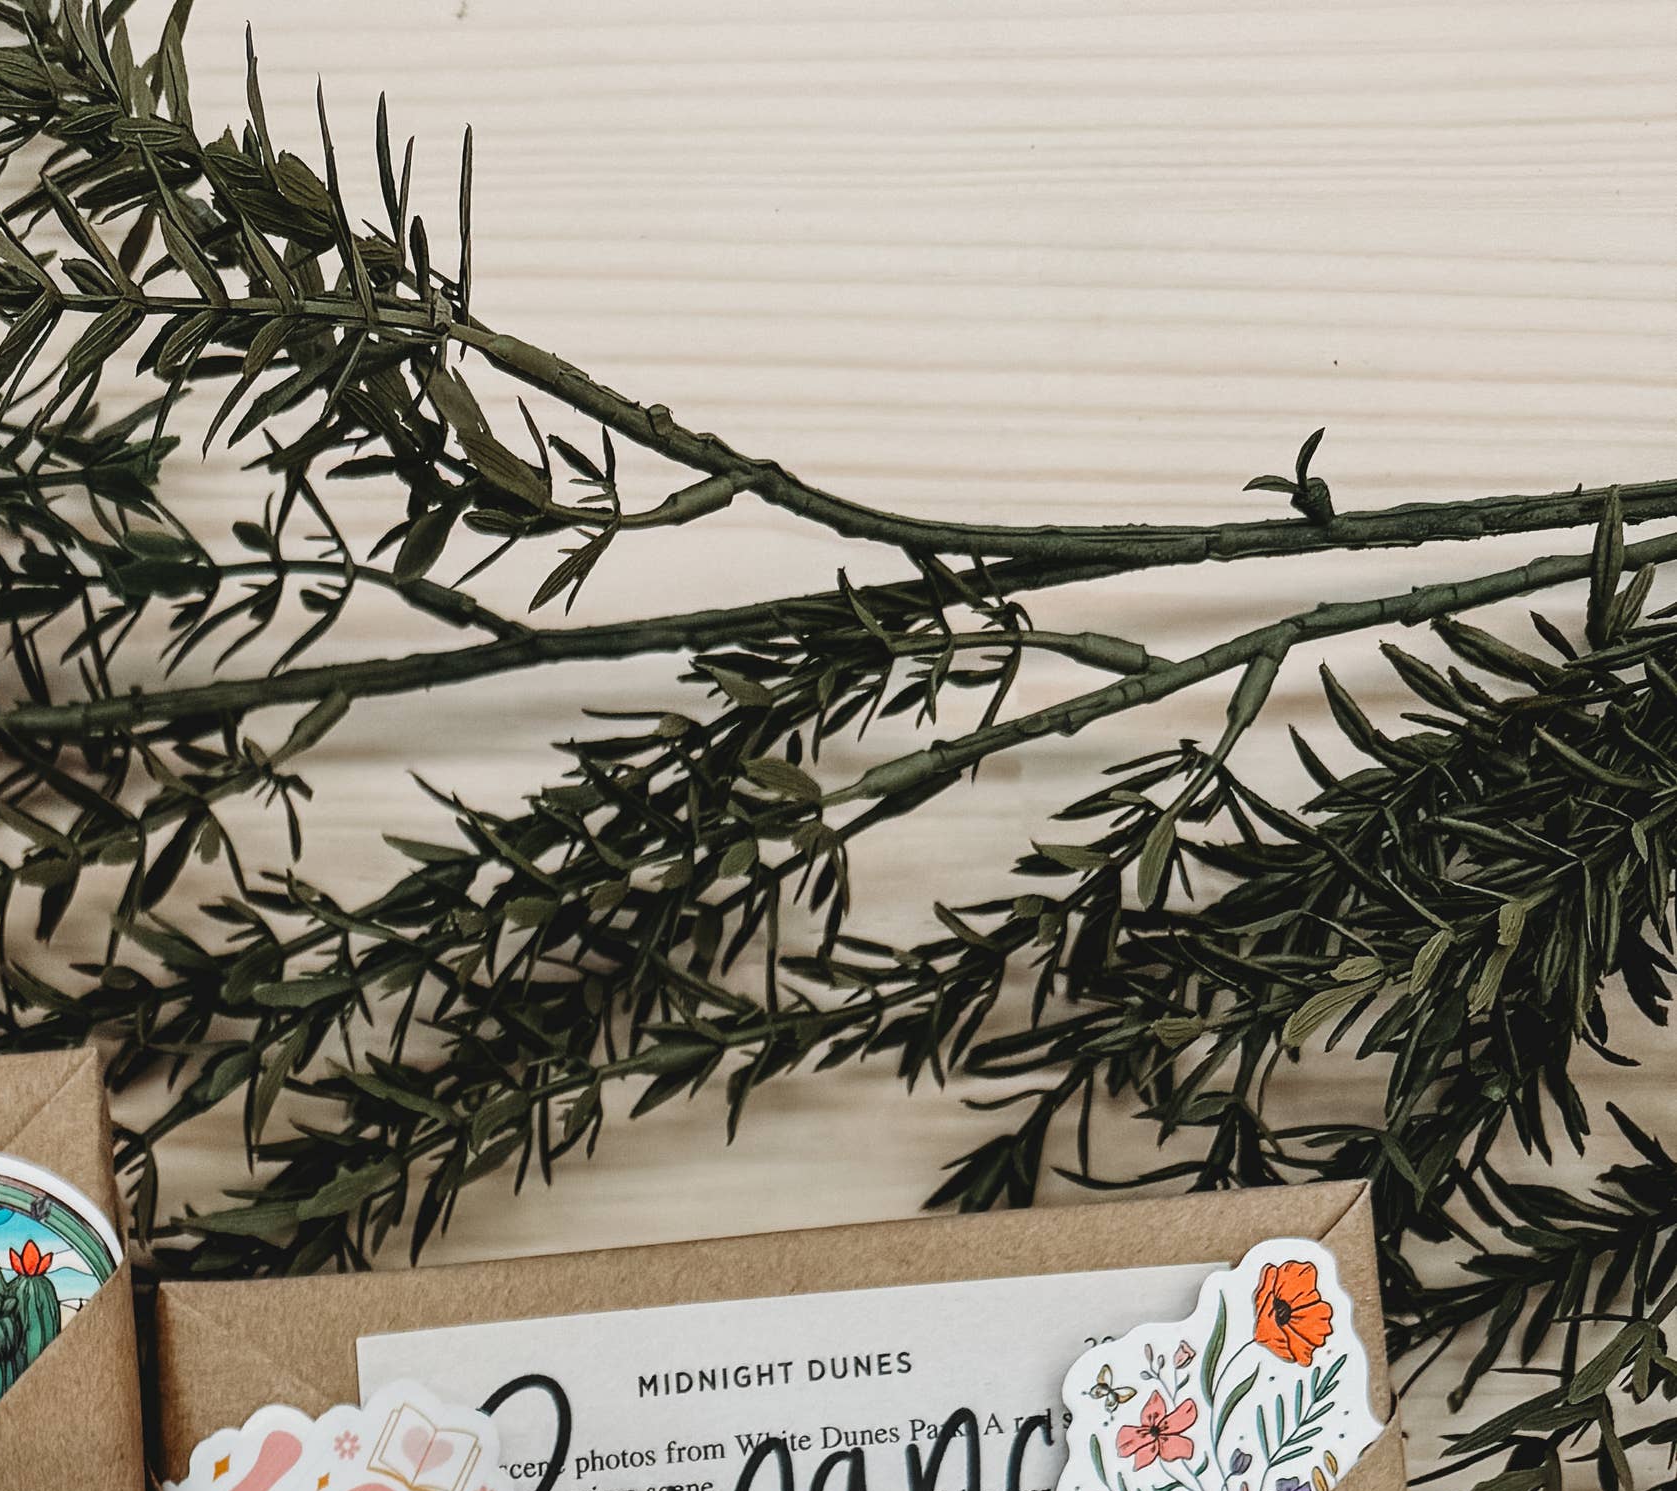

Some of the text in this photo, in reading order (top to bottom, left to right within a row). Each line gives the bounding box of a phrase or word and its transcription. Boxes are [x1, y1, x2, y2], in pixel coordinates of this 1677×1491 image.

[638, 1351, 913, 1398] MIDNIGHT DUNES
[575, 1449, 656, 1479] photos
[667, 1440, 726, 1465] from
[820, 1424, 900, 1450] Dunes
[984, 1412, 1005, 1435] A
